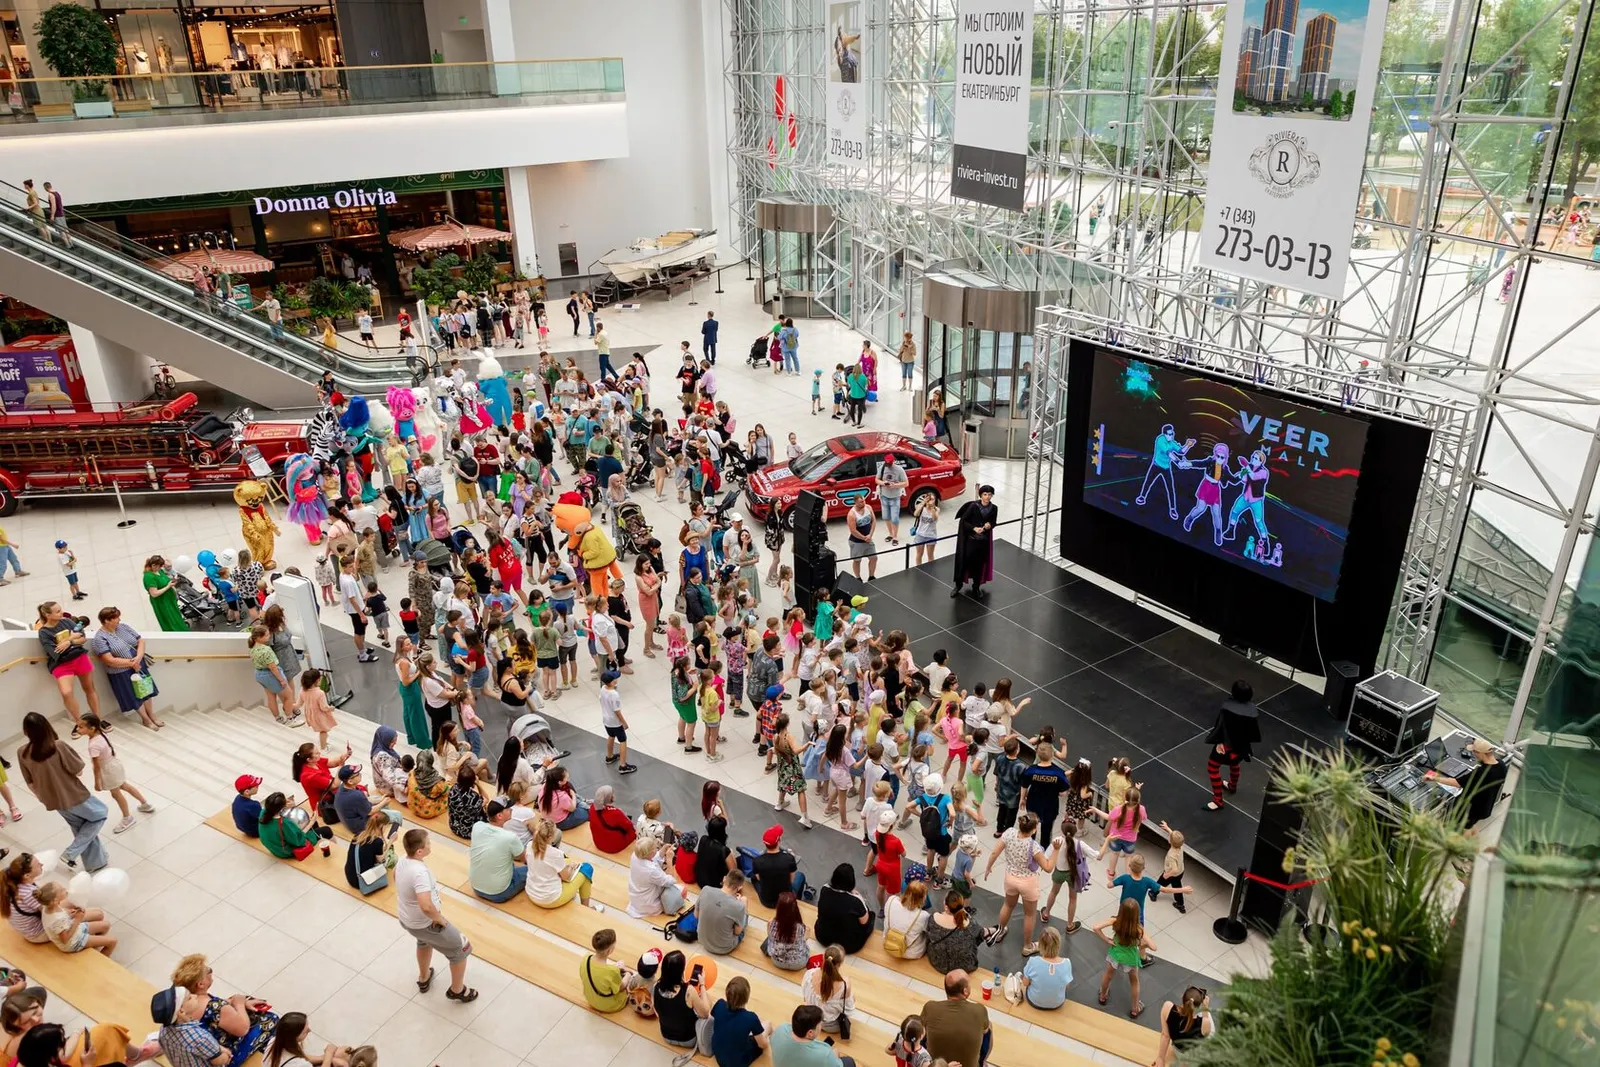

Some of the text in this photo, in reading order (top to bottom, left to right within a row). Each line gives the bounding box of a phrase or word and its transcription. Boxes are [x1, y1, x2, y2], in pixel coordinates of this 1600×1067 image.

[964, 11, 1025, 33] МЫ СТРОИМ
[963, 36, 1023, 77] НОВЫЙ
[961, 83, 1021, 103] ЕКАТЕРИНБУРГ
[831, 137, 863, 160] 273-03-13
[1274, 130, 1300, 144] RIVIERA
[1275, 150, 1290, 173] R
[957, 164, 1018, 189] riviera-invest.ru
[252, 187, 399, 216] Donna Olivia
[1219, 206, 1256, 228] +7 (343)
[1214, 224, 1332, 280] 273-03-13
[1240, 409, 1329, 457] VEER
[1260, 444, 1322, 472] MALL
[1032, 774, 1058, 783] RUSSIA
